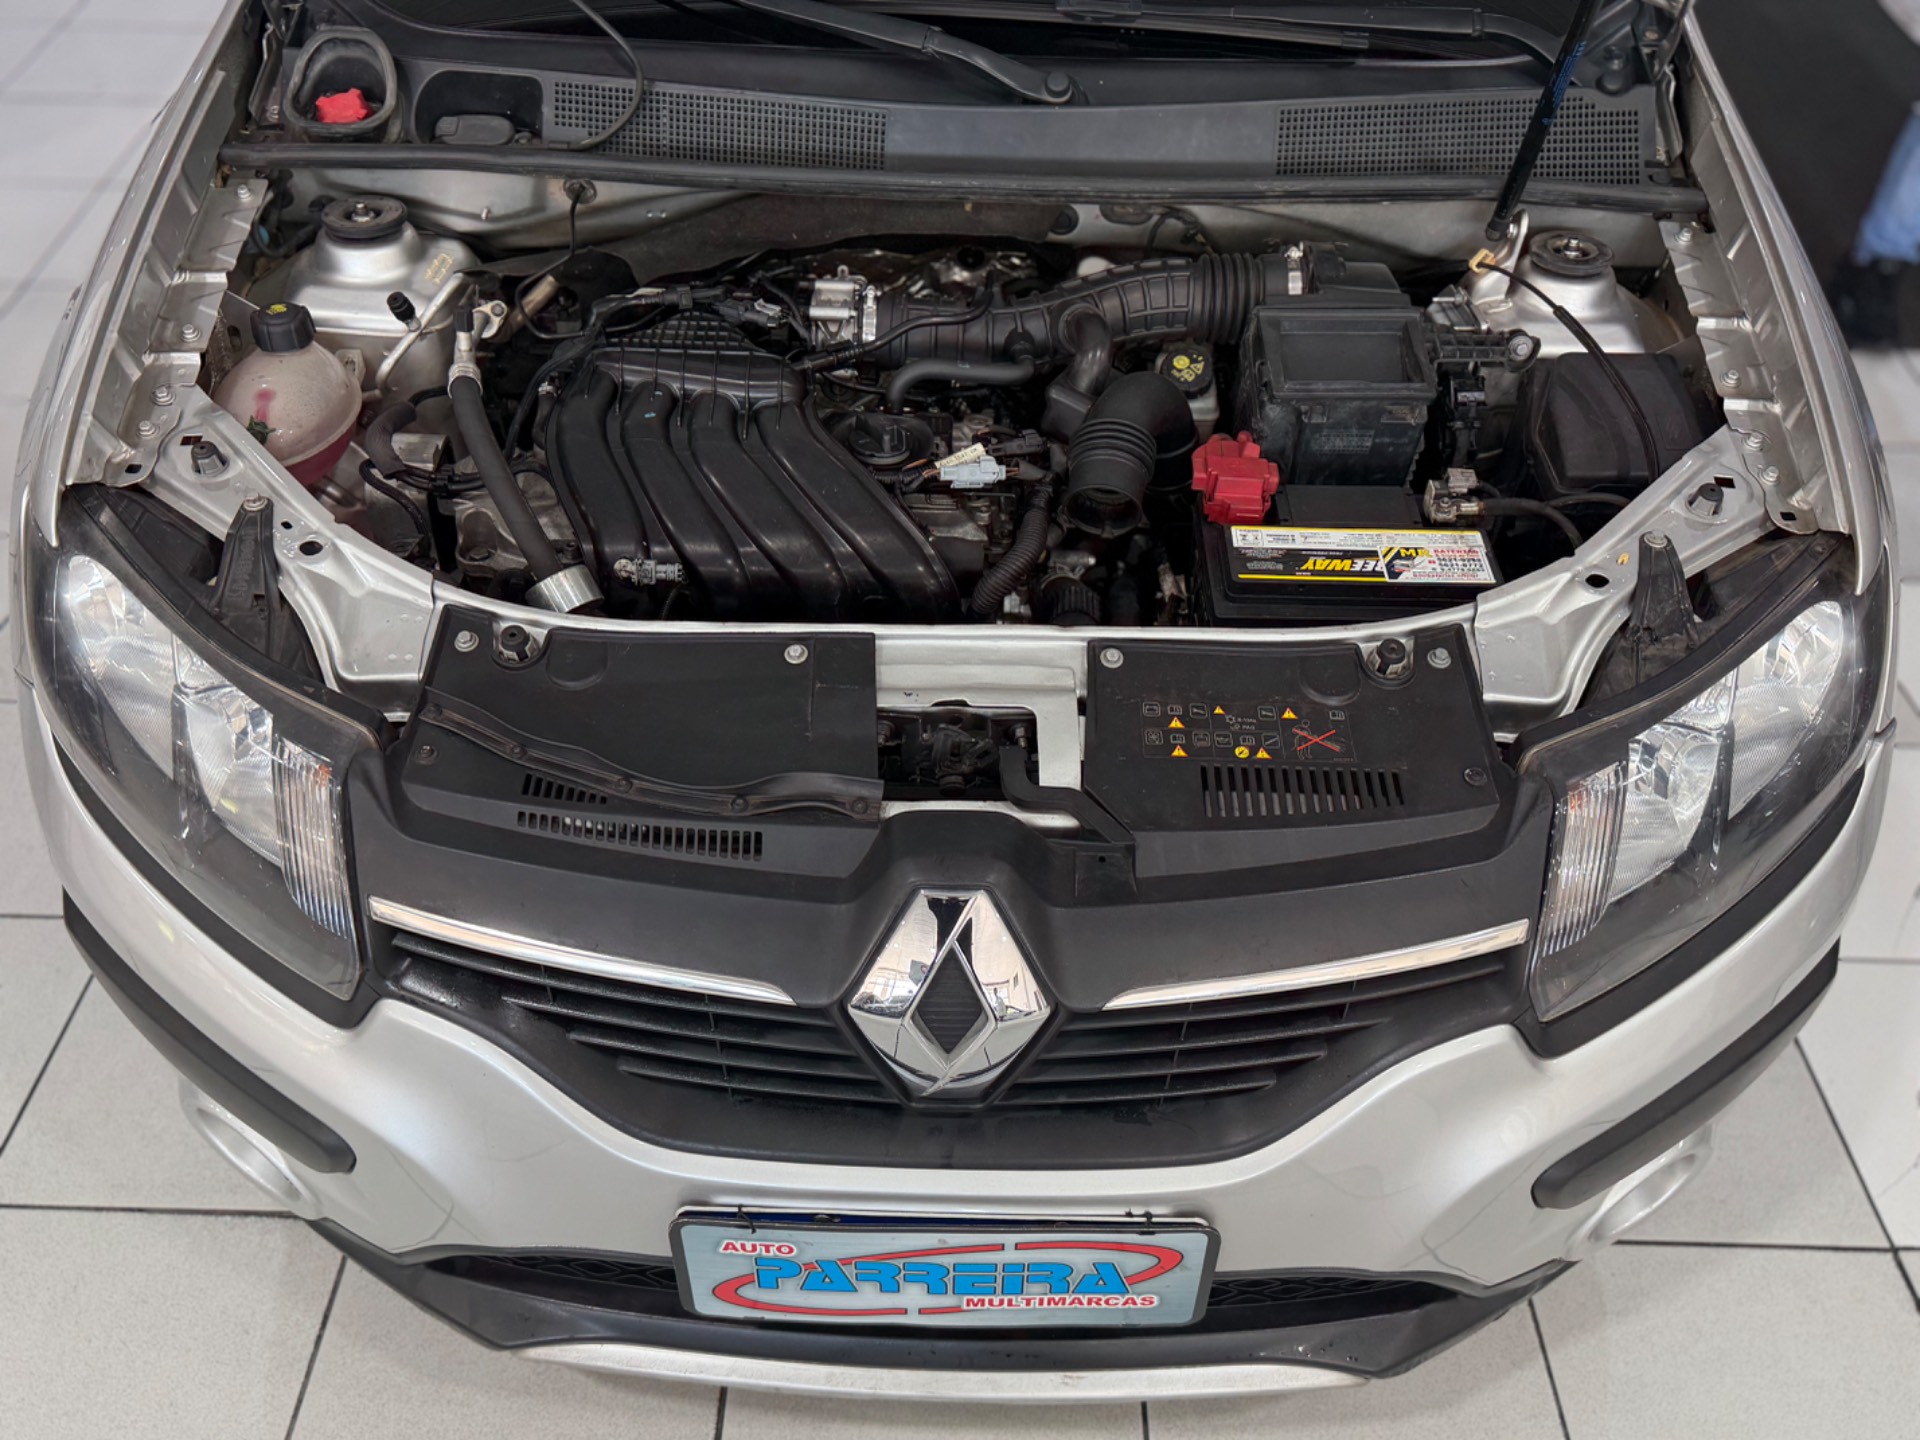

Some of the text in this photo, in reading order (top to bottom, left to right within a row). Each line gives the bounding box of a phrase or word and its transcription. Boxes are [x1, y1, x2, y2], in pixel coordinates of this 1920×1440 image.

[1400, 548, 1432, 558] MR
[1301, 559, 1384, 571] REEWAY
[721, 1241, 795, 1255] AUTO
[755, 1257, 1131, 1295] PARREIRA
[965, 1295, 1157, 1308] MULTIMARCAS
